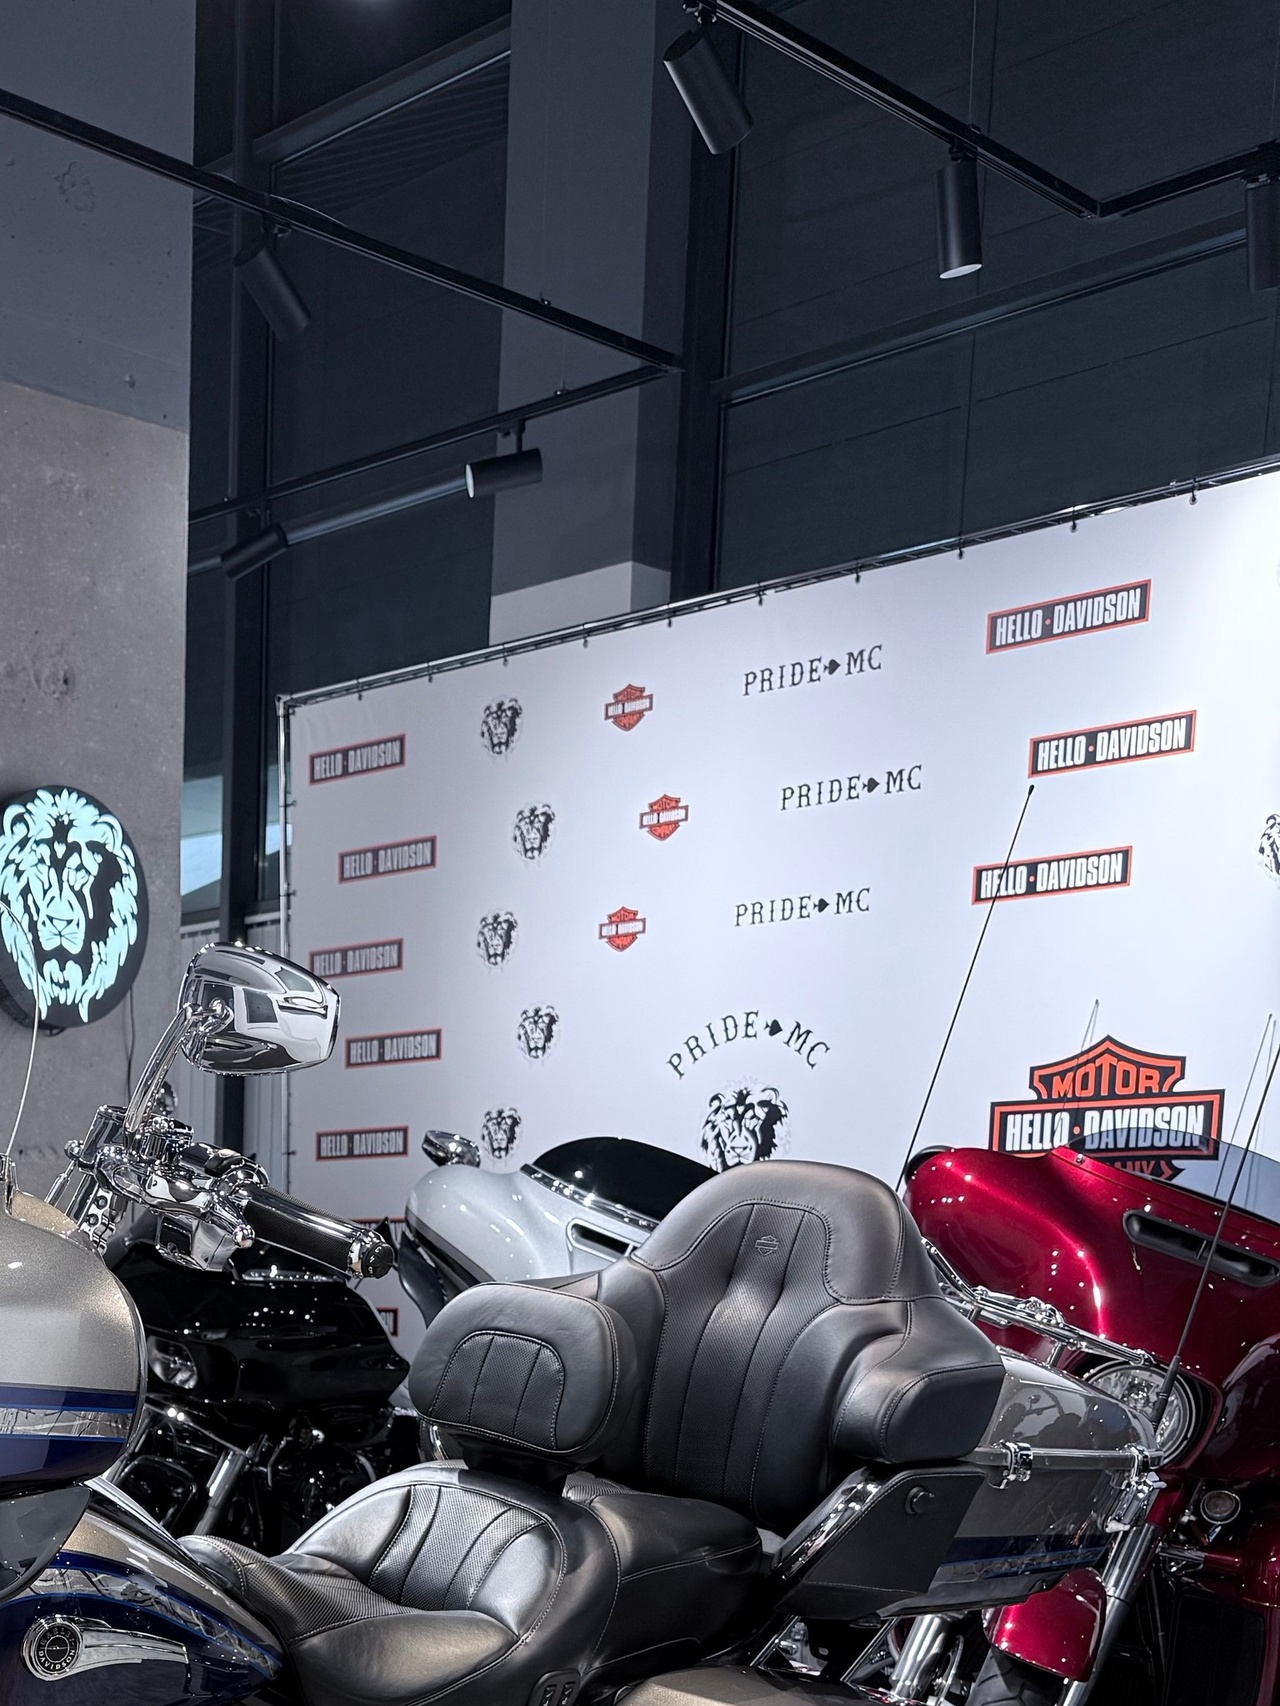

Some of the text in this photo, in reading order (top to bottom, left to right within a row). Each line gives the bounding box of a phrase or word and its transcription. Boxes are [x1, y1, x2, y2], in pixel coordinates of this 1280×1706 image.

[996, 588, 1141, 646] HELLO DAVIDSON
[743, 644, 882, 696] PRIDE MC
[1037, 718, 1187, 772] HELLO DAVIDSON
[780, 764, 922, 811] PRIDE MC
[980, 853, 1123, 898] HELLO DAVIDSON
[734, 887, 870, 927] PRIDE MC
[666, 1010, 830, 1080] PRIDE MC
[1051, 1053, 1161, 1100] MOTOR
[1005, 1104, 1205, 1152] HELLO DAVIDSON
[38, 1650, 76, 1670] DAVIDSON
